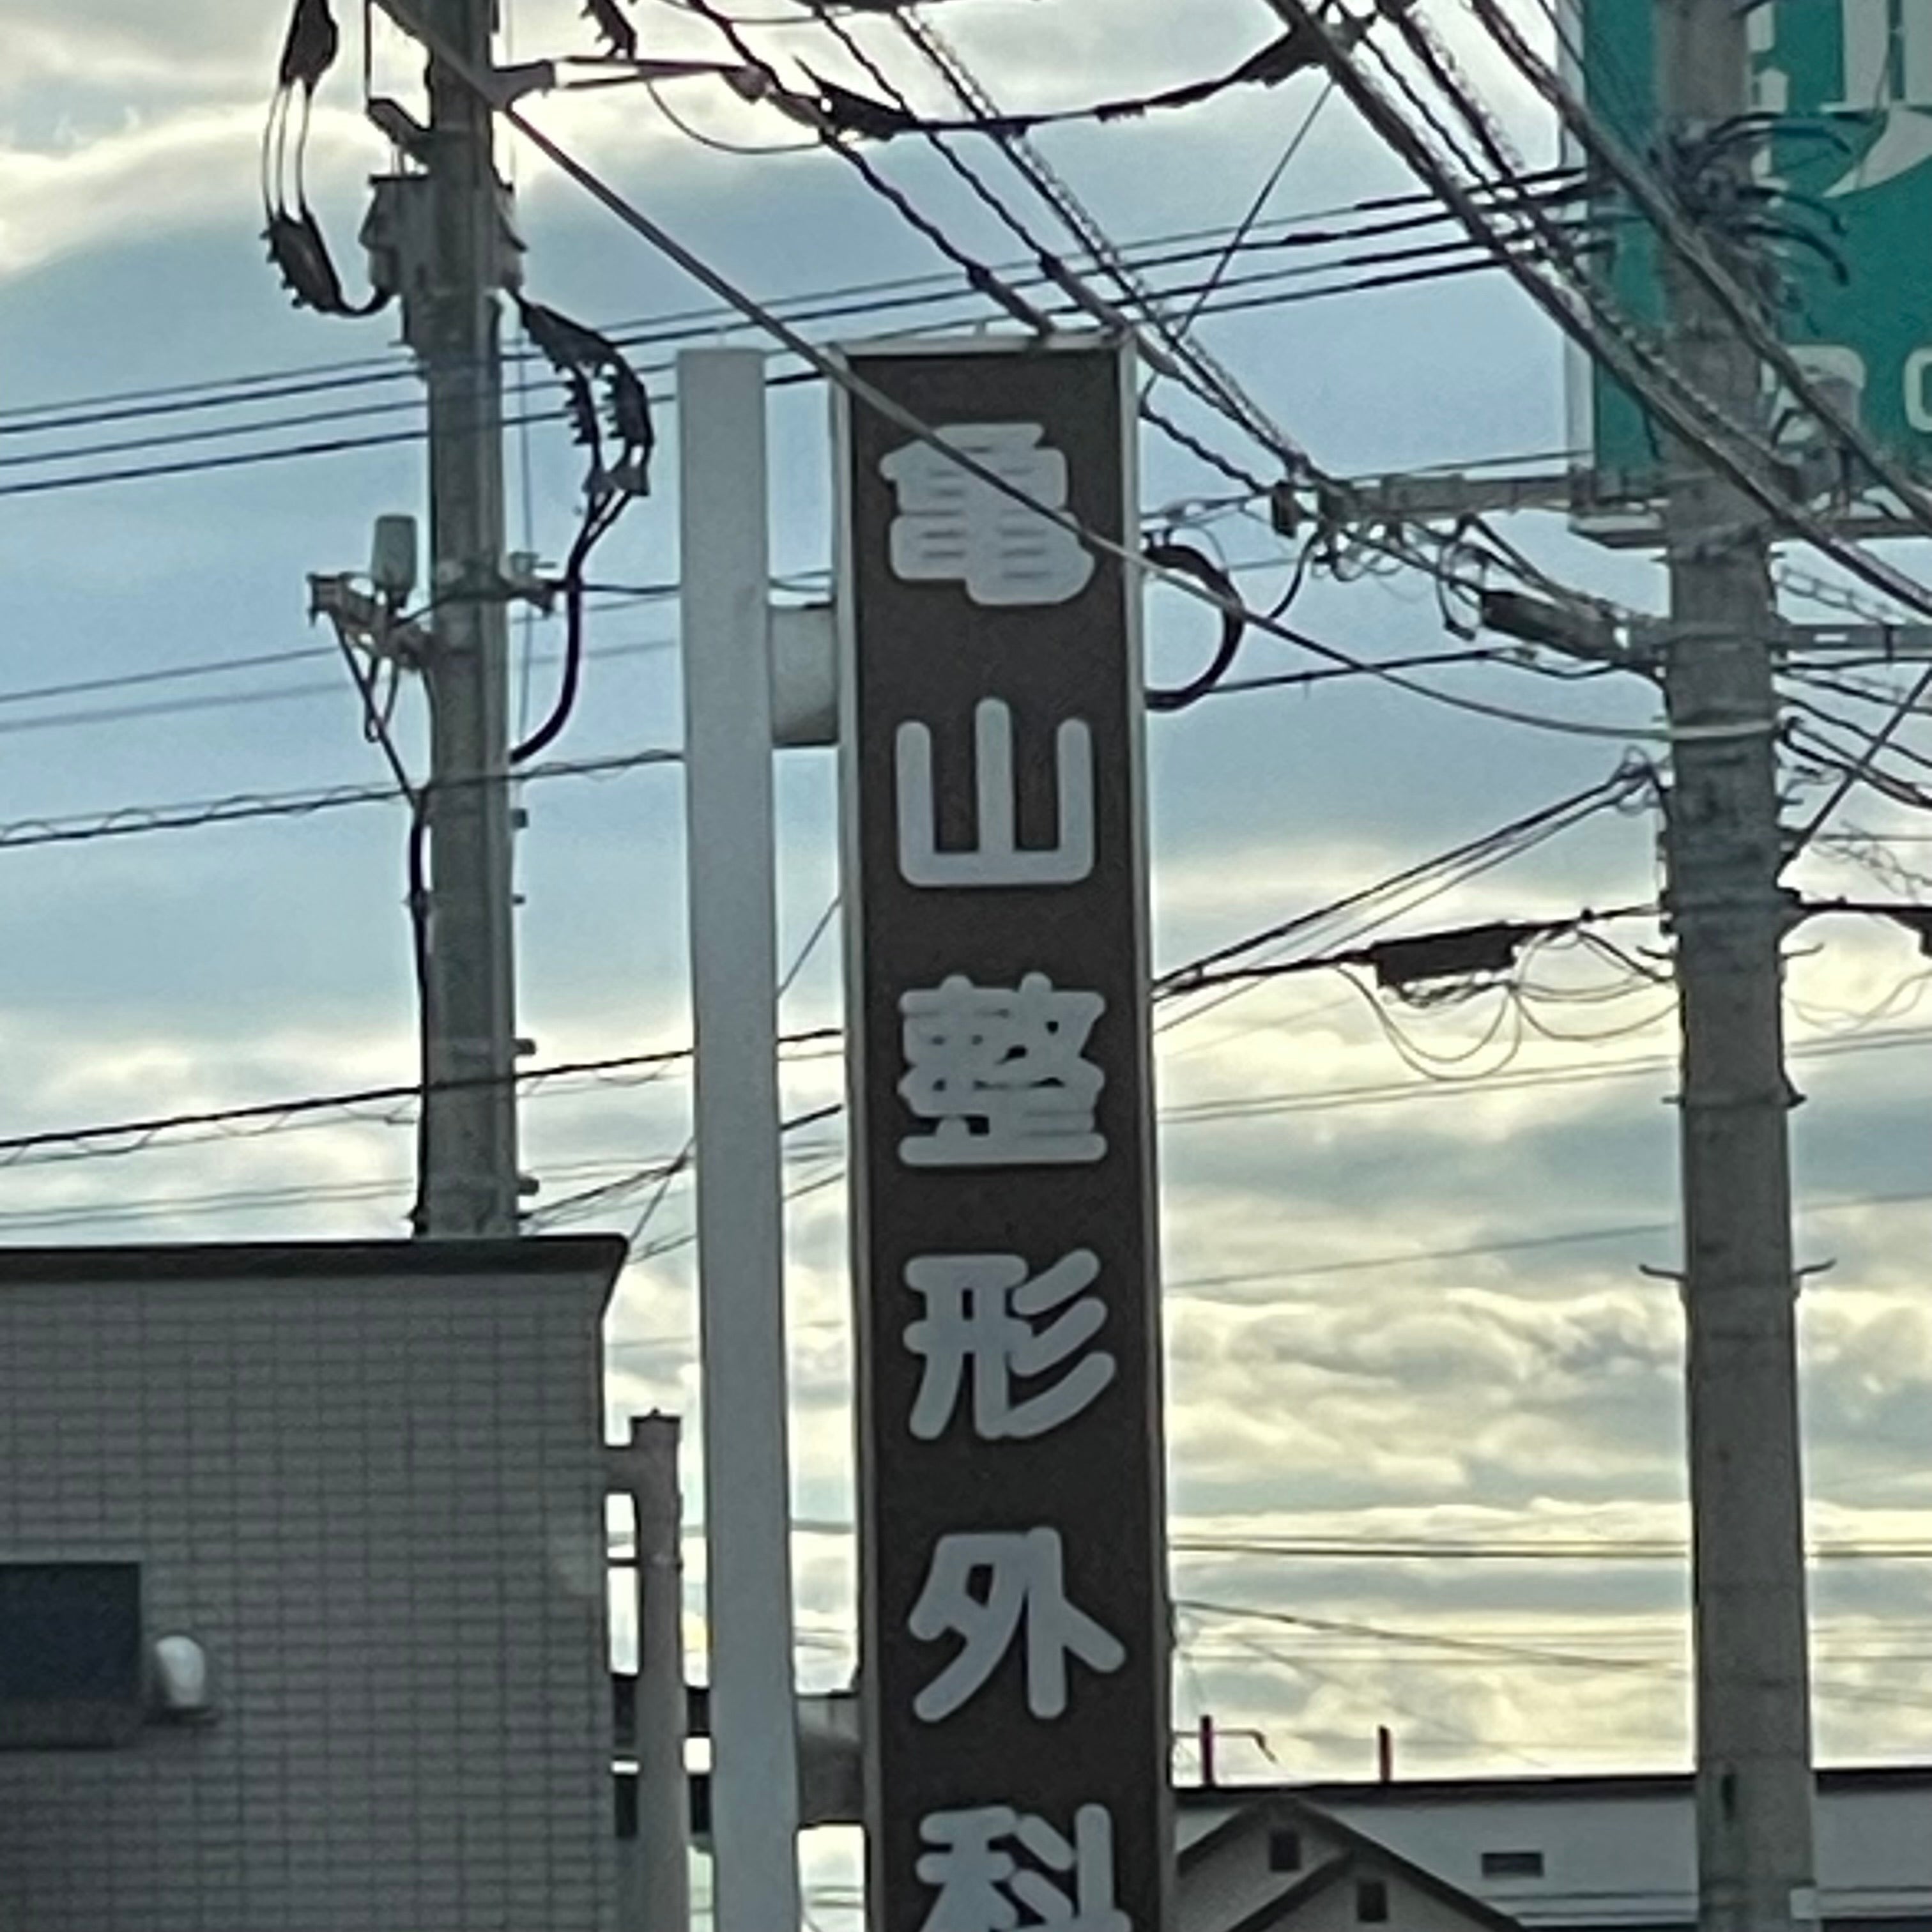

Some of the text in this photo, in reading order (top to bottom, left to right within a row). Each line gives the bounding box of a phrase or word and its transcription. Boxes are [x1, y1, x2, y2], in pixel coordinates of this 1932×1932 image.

[879, 422, 1131, 1932] 亀山整形外科
